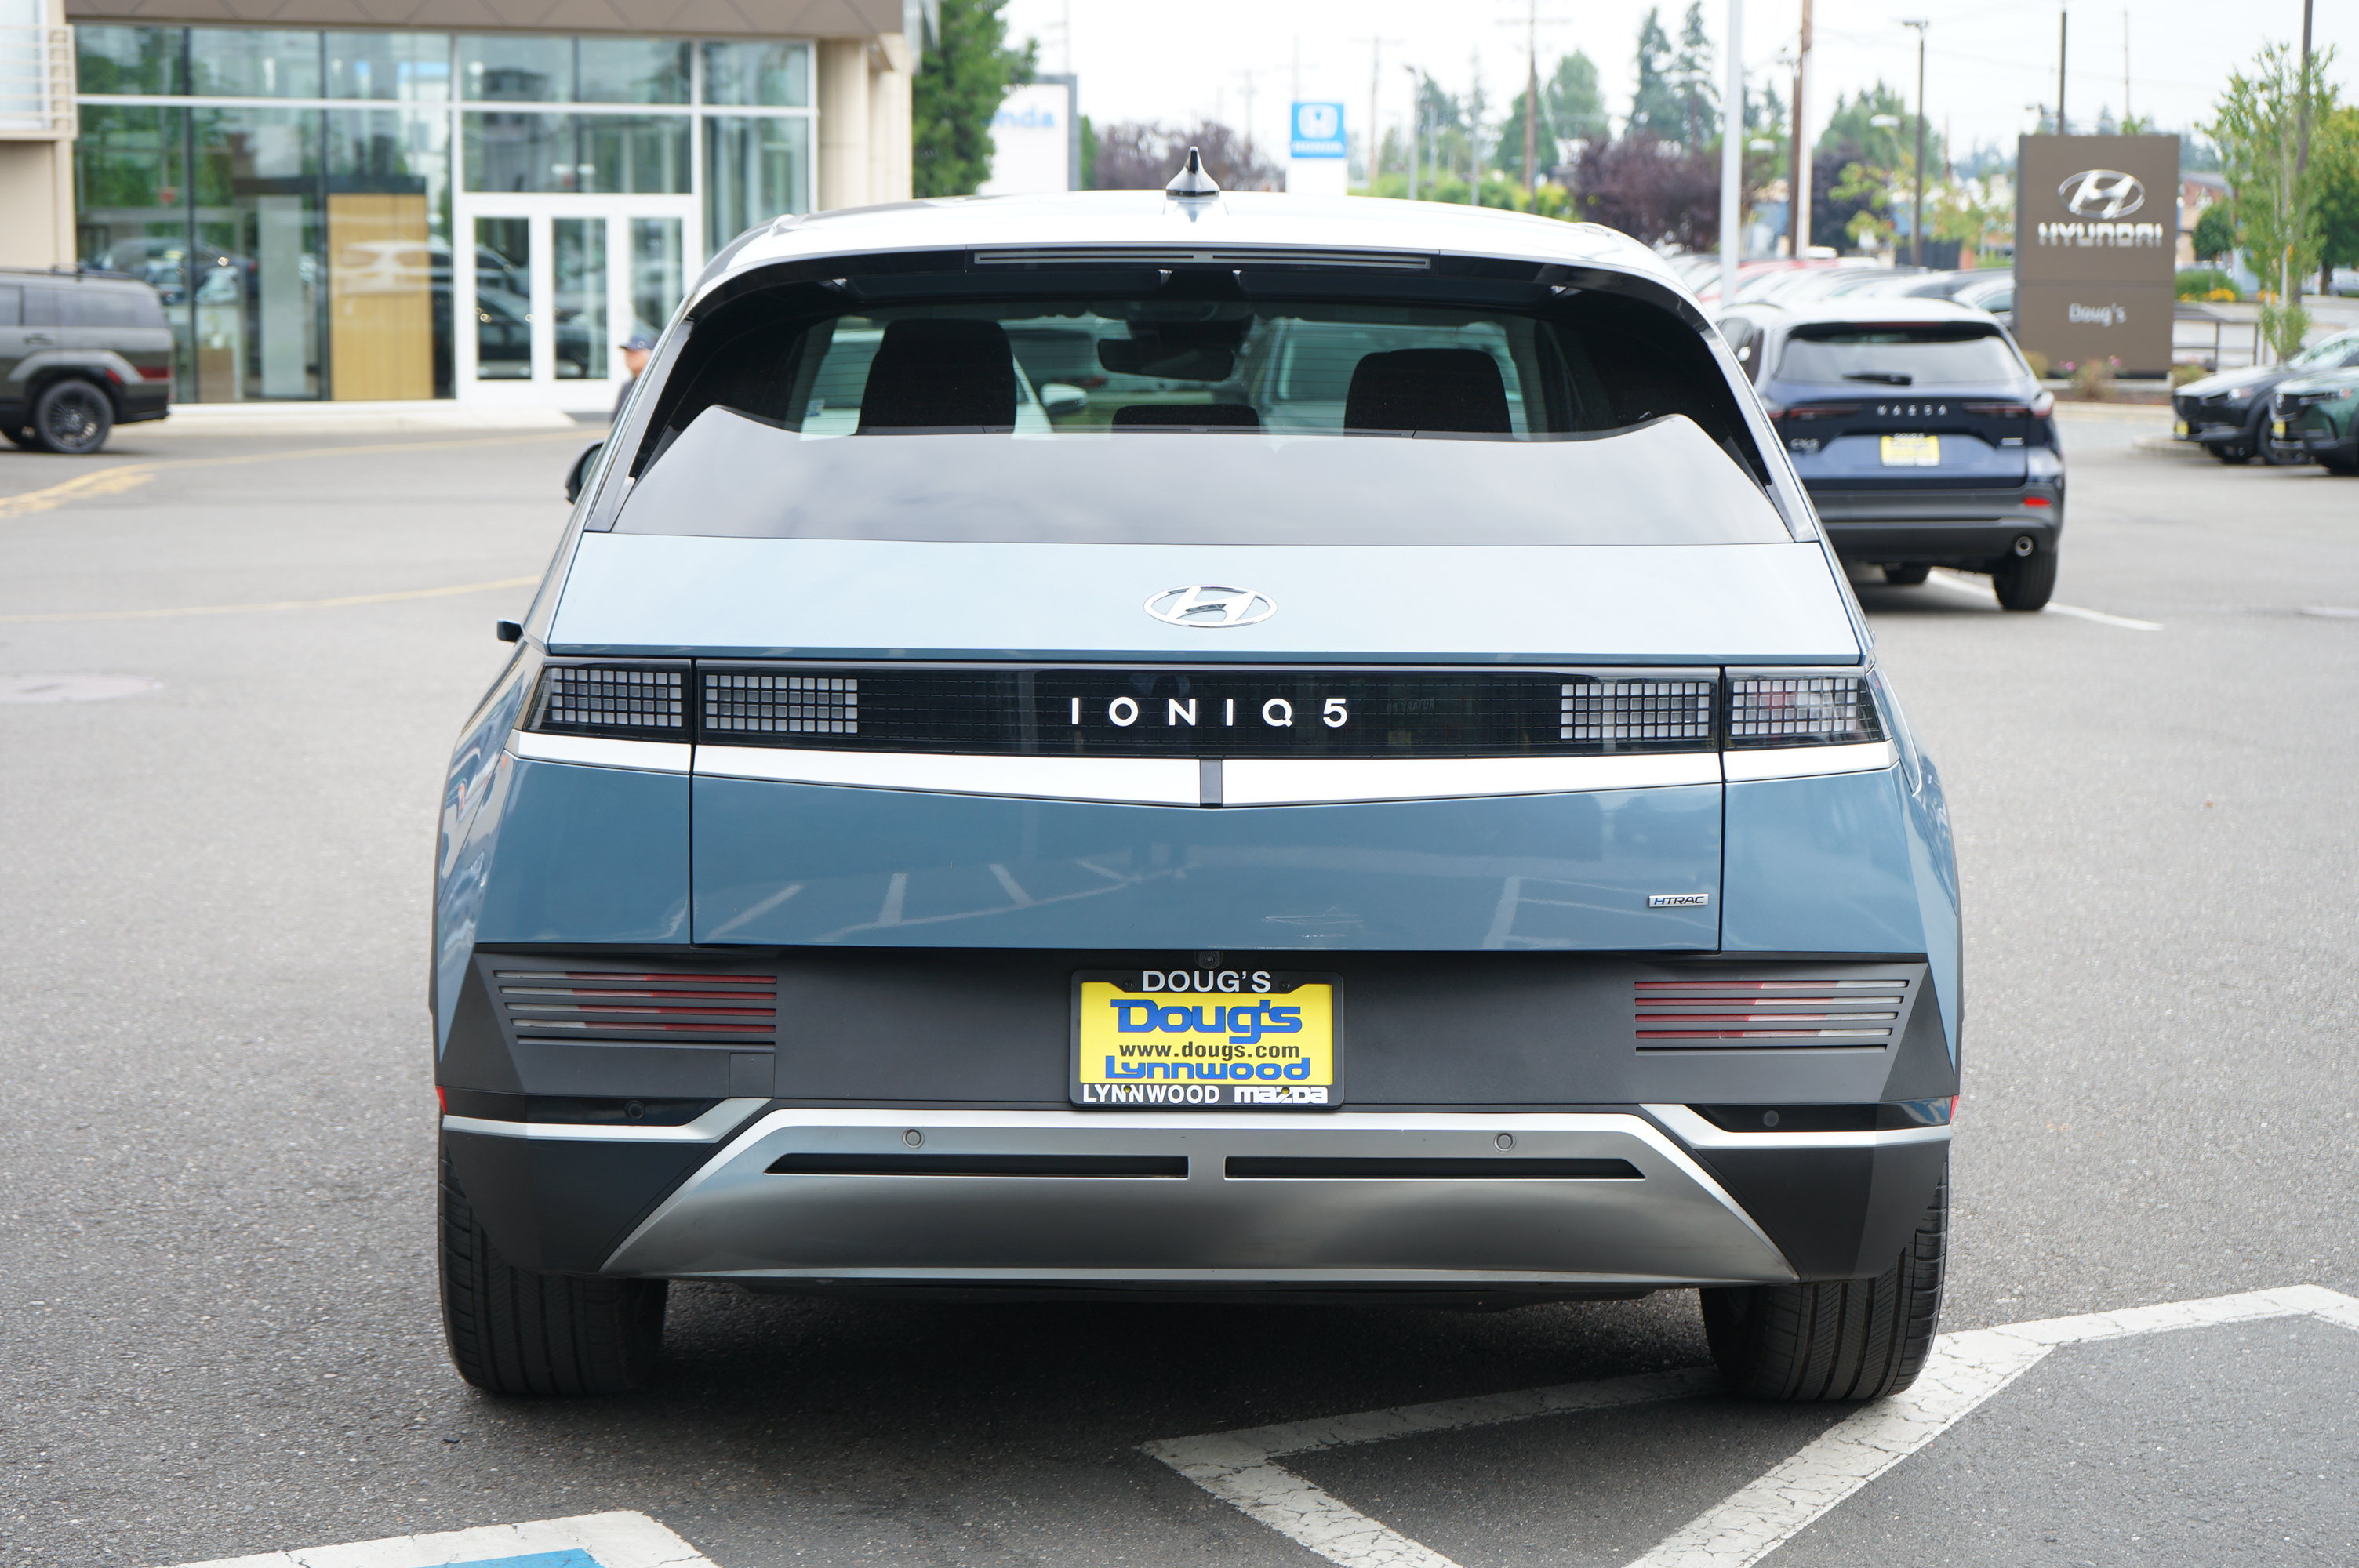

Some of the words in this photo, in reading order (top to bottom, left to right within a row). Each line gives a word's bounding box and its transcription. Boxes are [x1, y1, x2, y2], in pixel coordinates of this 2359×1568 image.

[2038, 222, 2163, 248] HYUNDAI
[2068, 303, 2128, 327] Doug's
[1071, 696, 1292, 728] IONIQ
[1322, 697, 1348, 728] 5
[1653, 896, 1705, 906] HTRAC
[1142, 970, 1271, 993] DOUG'S
[1110, 998, 1303, 1044] Doug's
[1119, 1041, 1299, 1061] www.dougs.com
[1105, 1055, 1310, 1080] Lynnwood
[1083, 1083, 1220, 1104] LYNNWOOD
